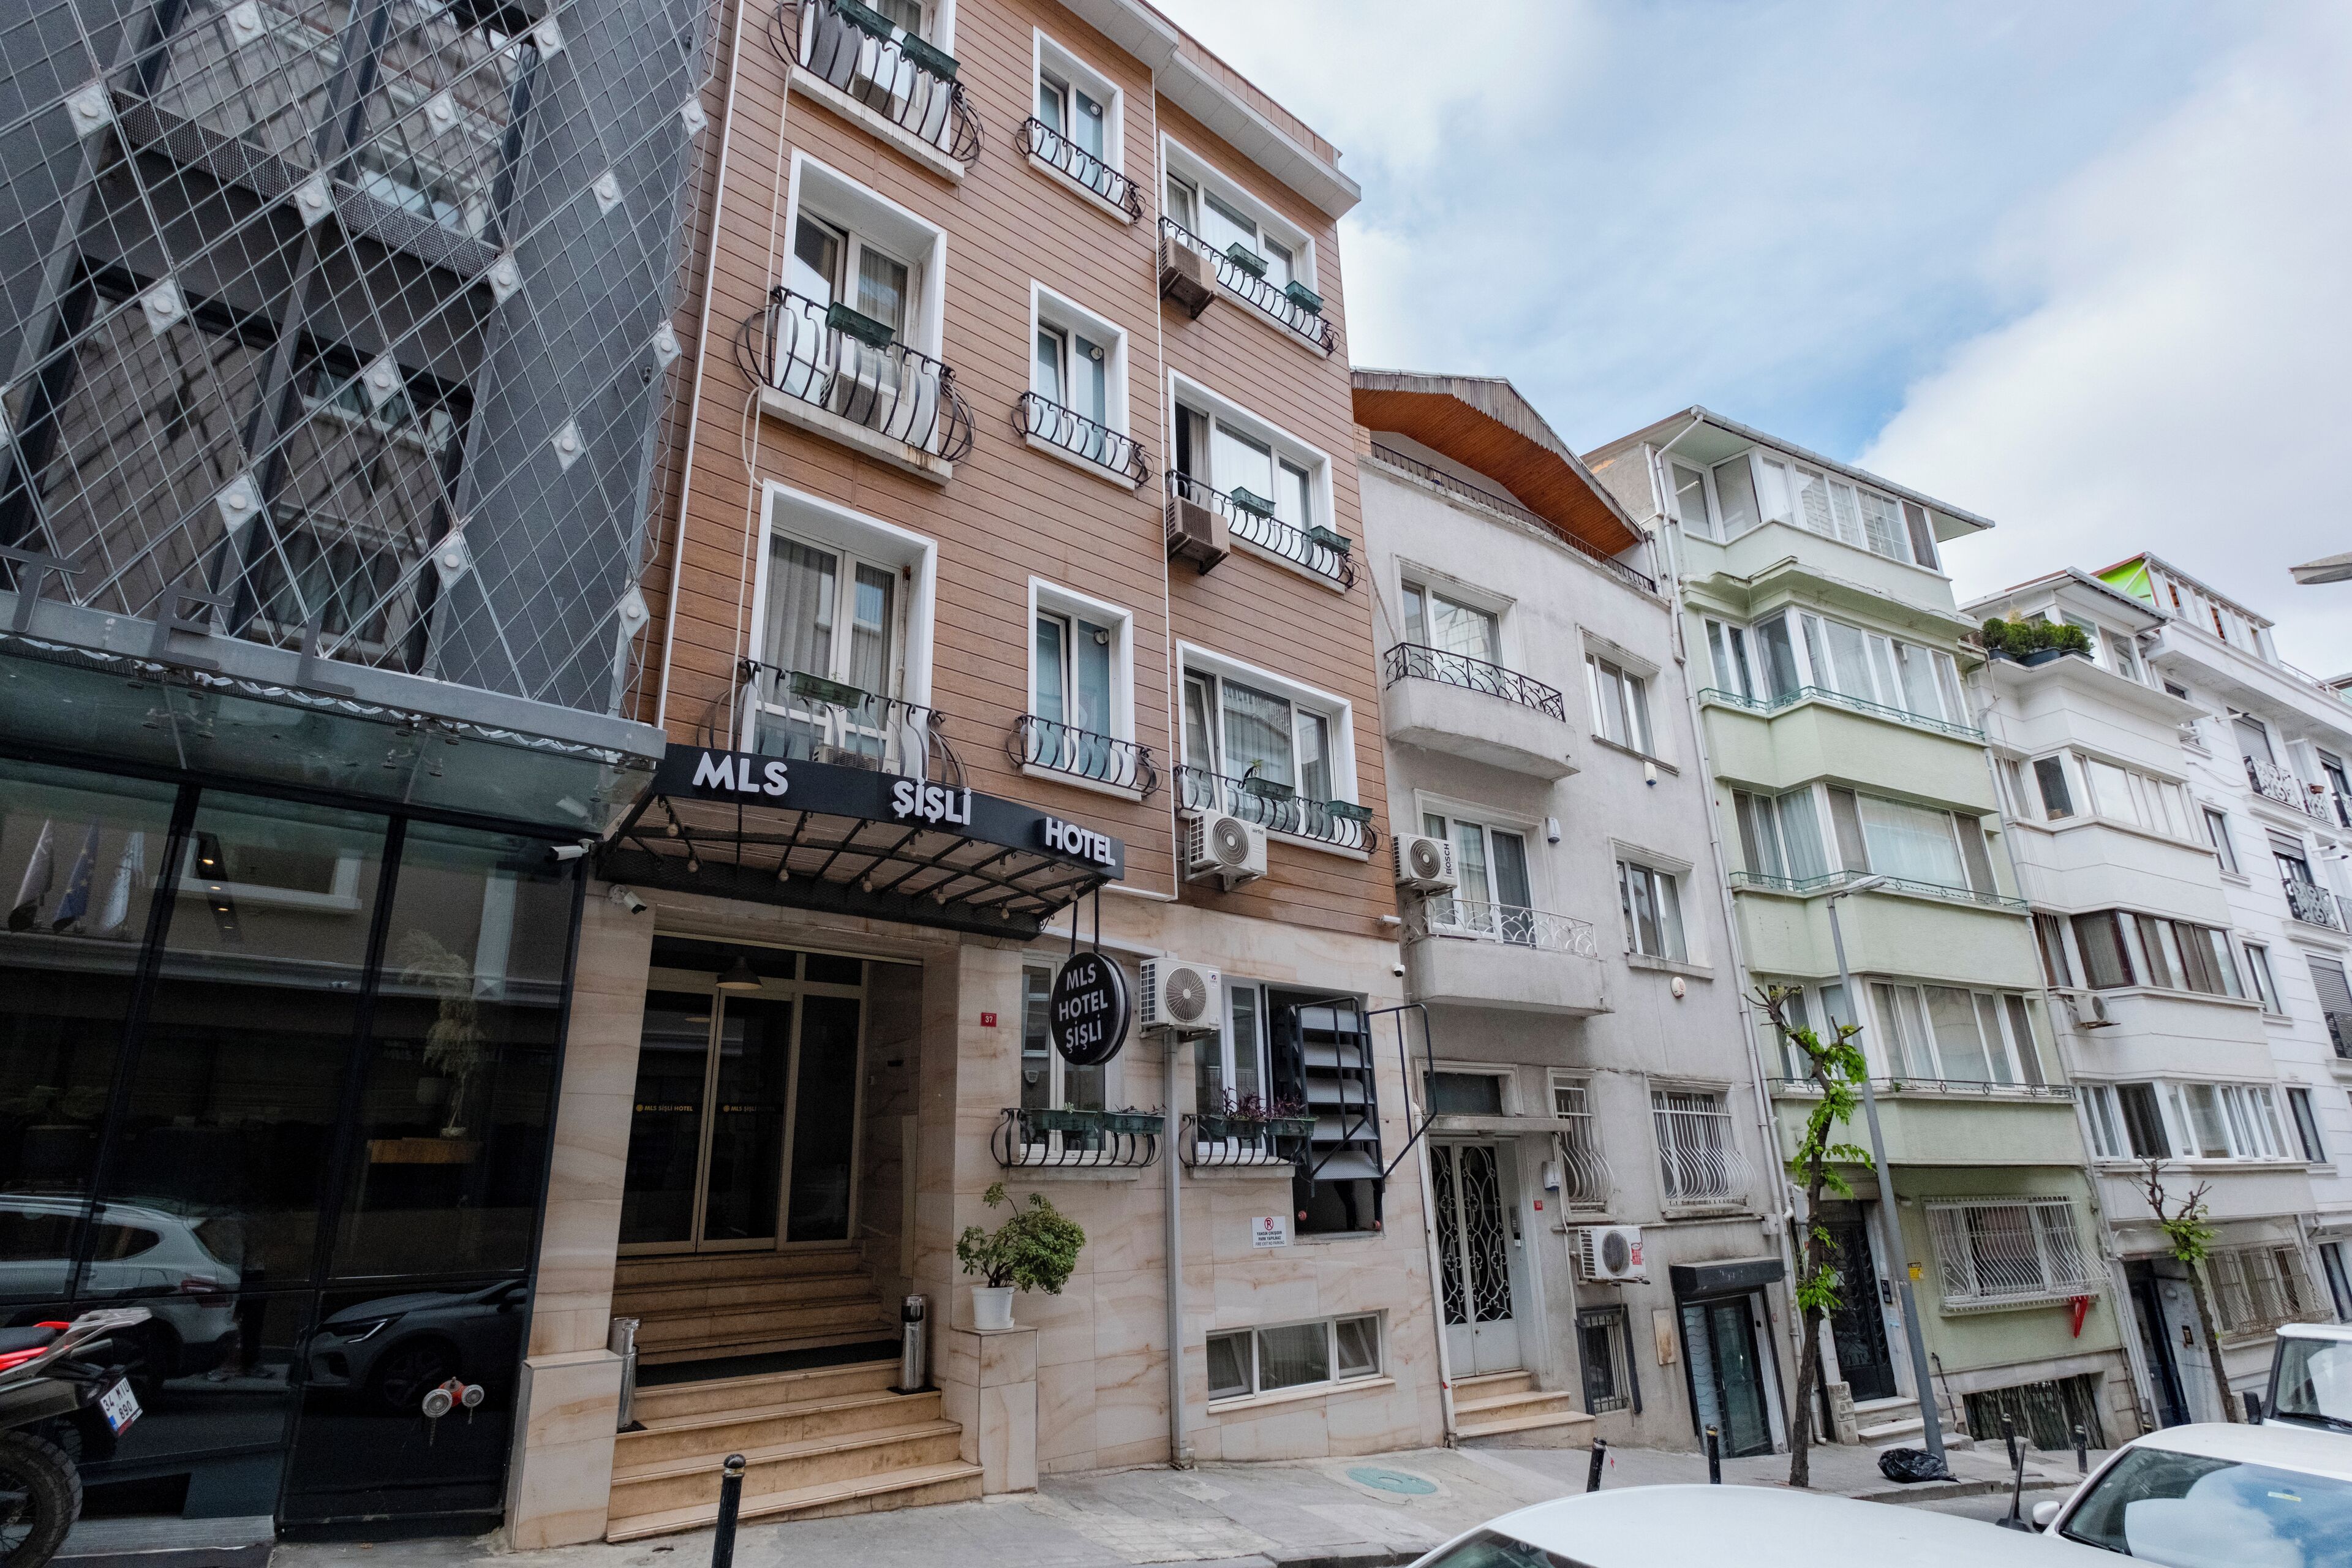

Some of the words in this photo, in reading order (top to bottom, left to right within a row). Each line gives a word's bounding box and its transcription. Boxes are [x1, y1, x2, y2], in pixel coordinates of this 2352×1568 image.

[692, 752, 788, 796] MLS
[892, 777, 971, 825] ŞİŞLİ
[1046, 816, 1115, 866] HOTEL
[1066, 963, 1096, 991] MLS
[1058, 989, 1108, 1022] HOTEL
[1066, 1014, 1102, 1054] ŞİŞLİ
[104, 1395, 115, 1411] 34
[119, 1400, 132, 1419] 890
